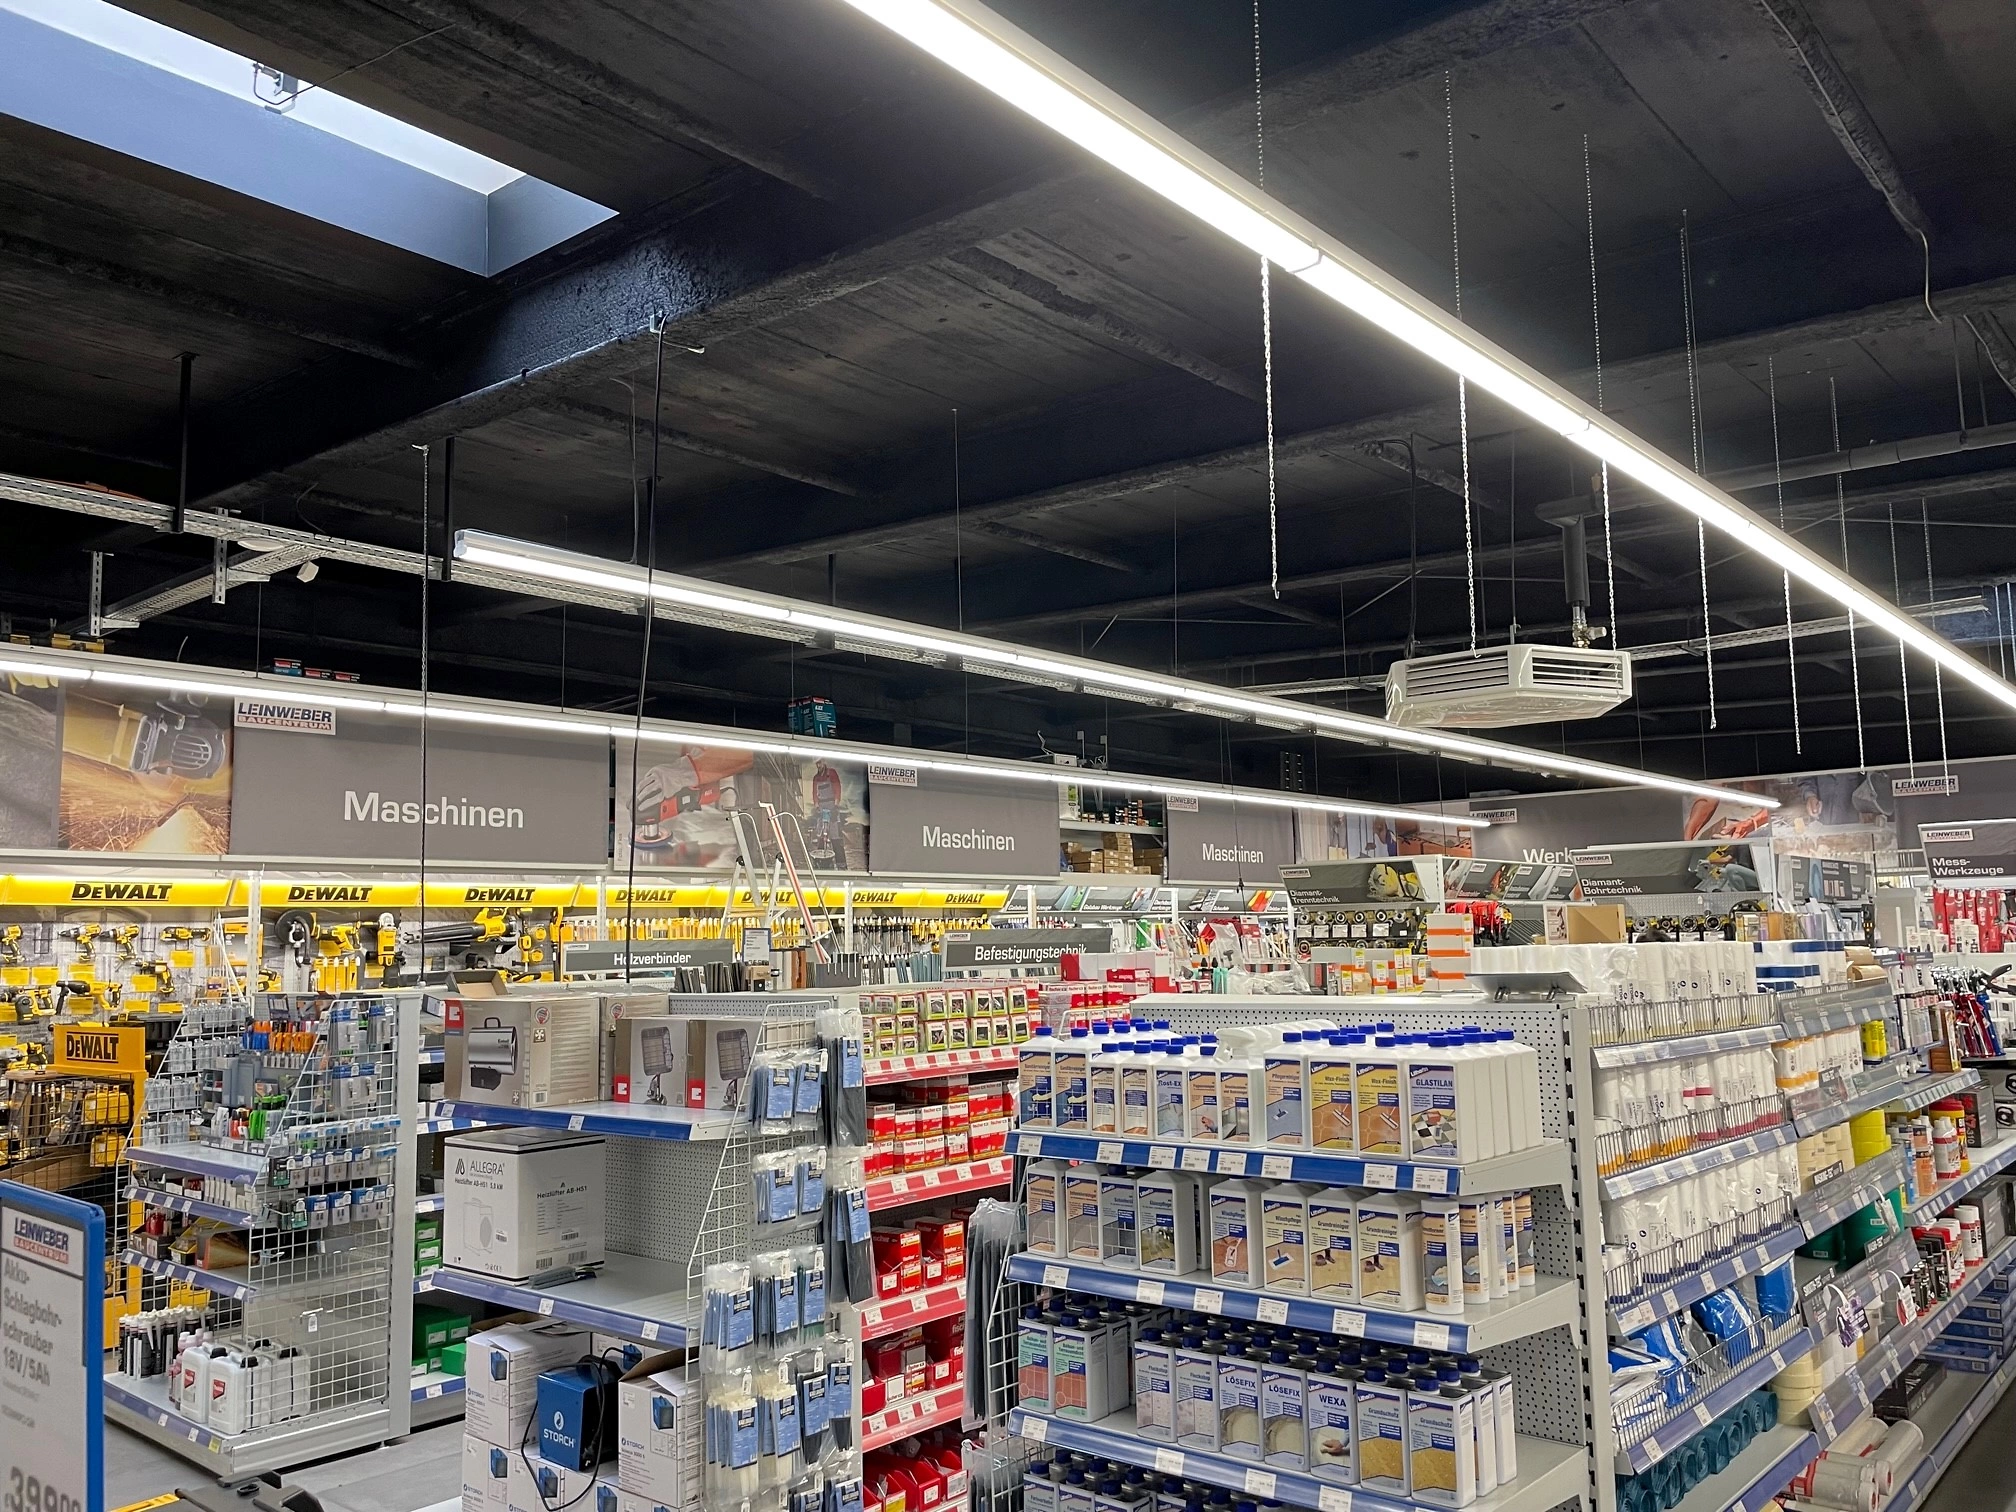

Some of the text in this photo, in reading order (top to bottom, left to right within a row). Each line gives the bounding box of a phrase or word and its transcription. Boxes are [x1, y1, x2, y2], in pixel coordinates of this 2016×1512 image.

[238, 702, 332, 722] LEINWEBER
[237, 714, 332, 731] BAUCENTRUM
[869, 765, 916, 778] LEINWEBER
[1895, 778, 1956, 789] LEINWEBER
[344, 790, 525, 829] Maschinen
[923, 825, 1015, 851] Maschinen
[1202, 843, 1264, 864] Maschinen
[1523, 847, 1573, 864] Werk
[1932, 857, 1971, 867] Mess-
[1933, 866, 2004, 877] Werkzeuge
[1581, 878, 1625, 888] Diamant-
[1289, 889, 1322, 897] Diamant-
[1583, 886, 1643, 895] Bohrtechnik
[1291, 896, 1340, 904] Trenntechnik
[613, 953, 692, 966] Holzverbinder
[974, 943, 1087, 963] Befestigungstechnik
[1416, 1078, 1453, 1088] GLASTILAN
[470, 1160, 504, 1176] ALLEGRA
[536, 1189, 566, 1199] Heizlüfter
[14, 1217, 69, 1251] LEINWEBER
[4, 1286, 62, 1327] Schlagbohr-
[3, 1321, 54, 1356] schrauber
[1225, 1375, 1256, 1389] LÖSEFIX
[1268, 1384, 1301, 1398] LÖSEFIX
[1319, 1394, 1347, 1408] WEXA
[543, 1429, 575, 1448] STORCH
